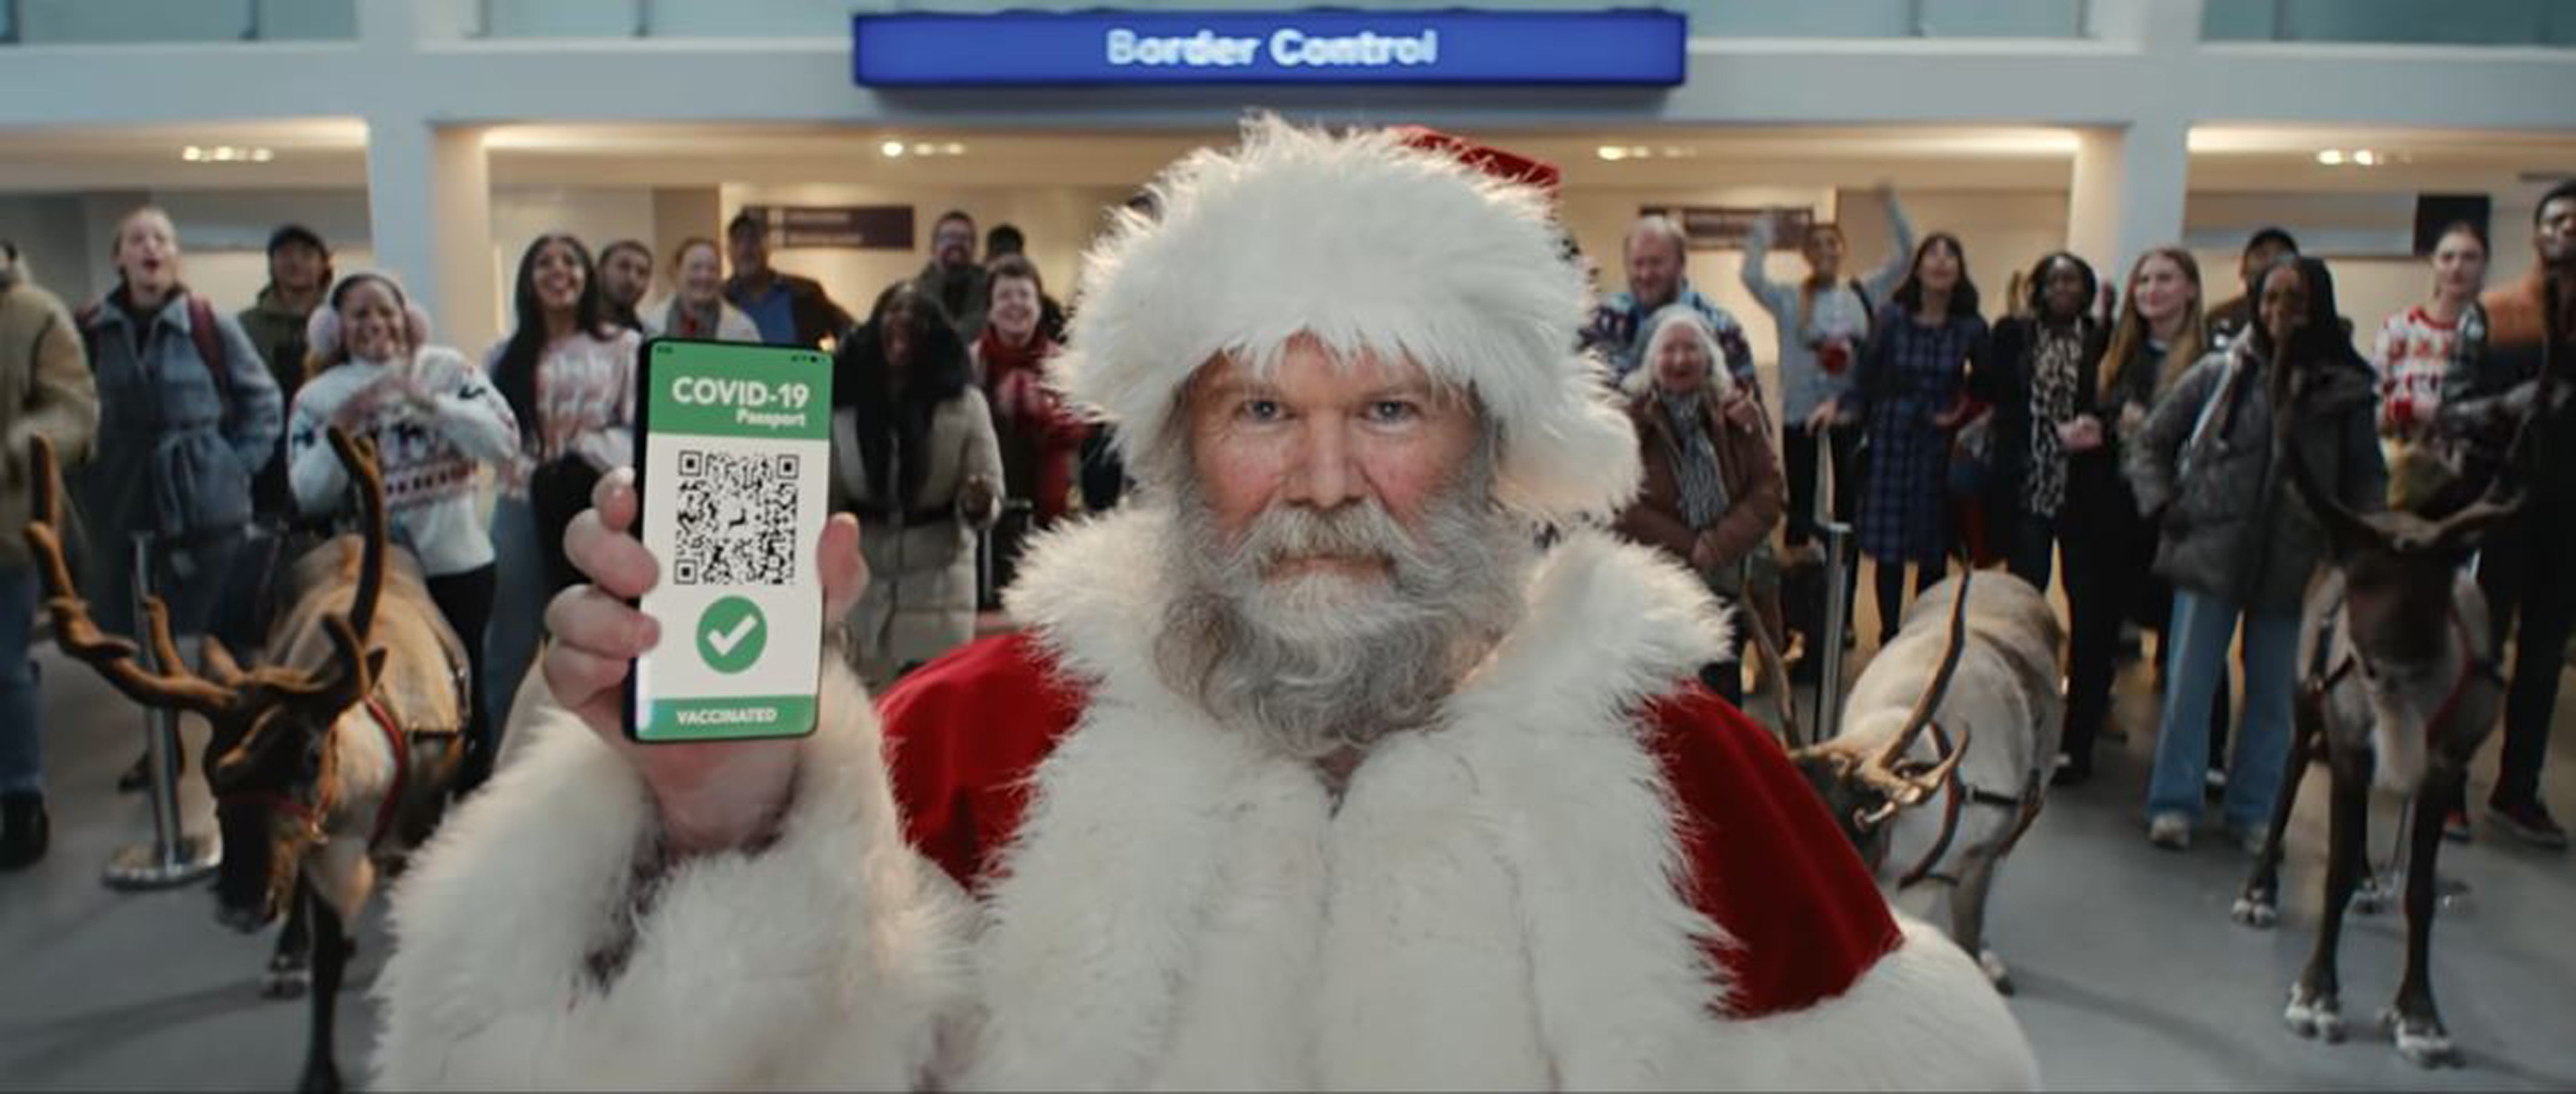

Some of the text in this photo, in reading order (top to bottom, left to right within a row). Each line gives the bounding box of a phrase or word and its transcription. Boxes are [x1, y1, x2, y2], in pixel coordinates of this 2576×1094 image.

[1107, 29, 1438, 65] Border Control
[672, 376, 809, 409] COVID-19
[736, 408, 805, 429] Passport
[676, 707, 777, 725] VACCINATED
